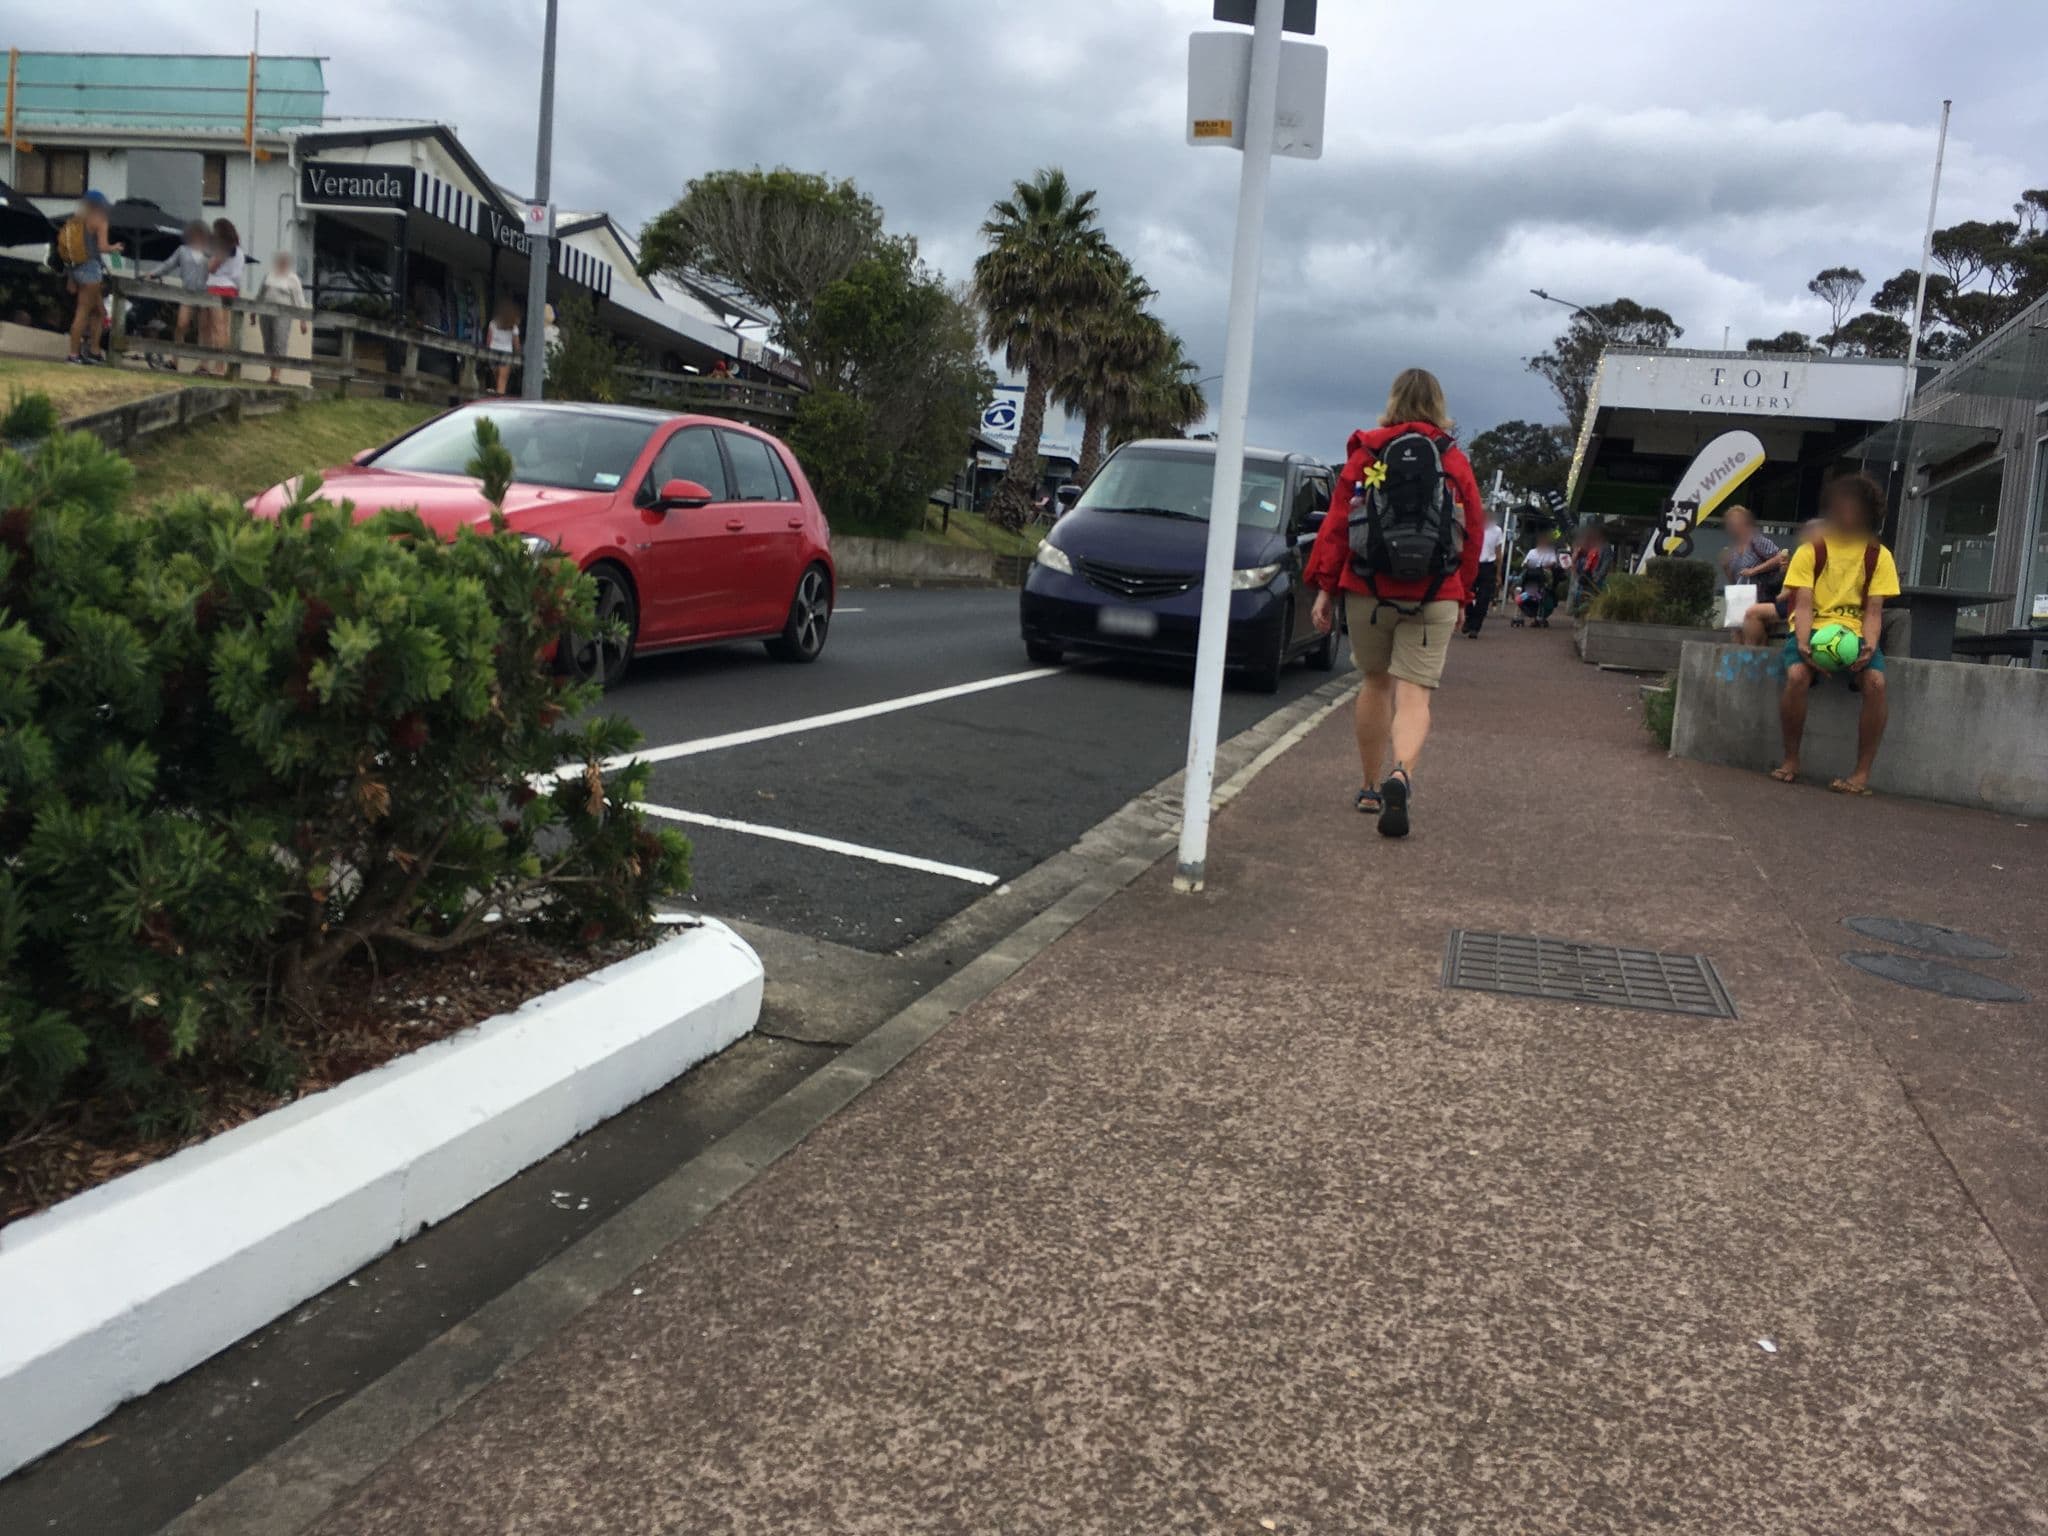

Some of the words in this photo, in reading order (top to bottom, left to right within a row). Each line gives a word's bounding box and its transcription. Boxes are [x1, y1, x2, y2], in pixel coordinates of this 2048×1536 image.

[308, 168, 402, 198] Veranda
[1711, 367, 1789, 389] TOI
[1700, 393, 1793, 409] GALLERY
[1700, 451, 1746, 491] White
